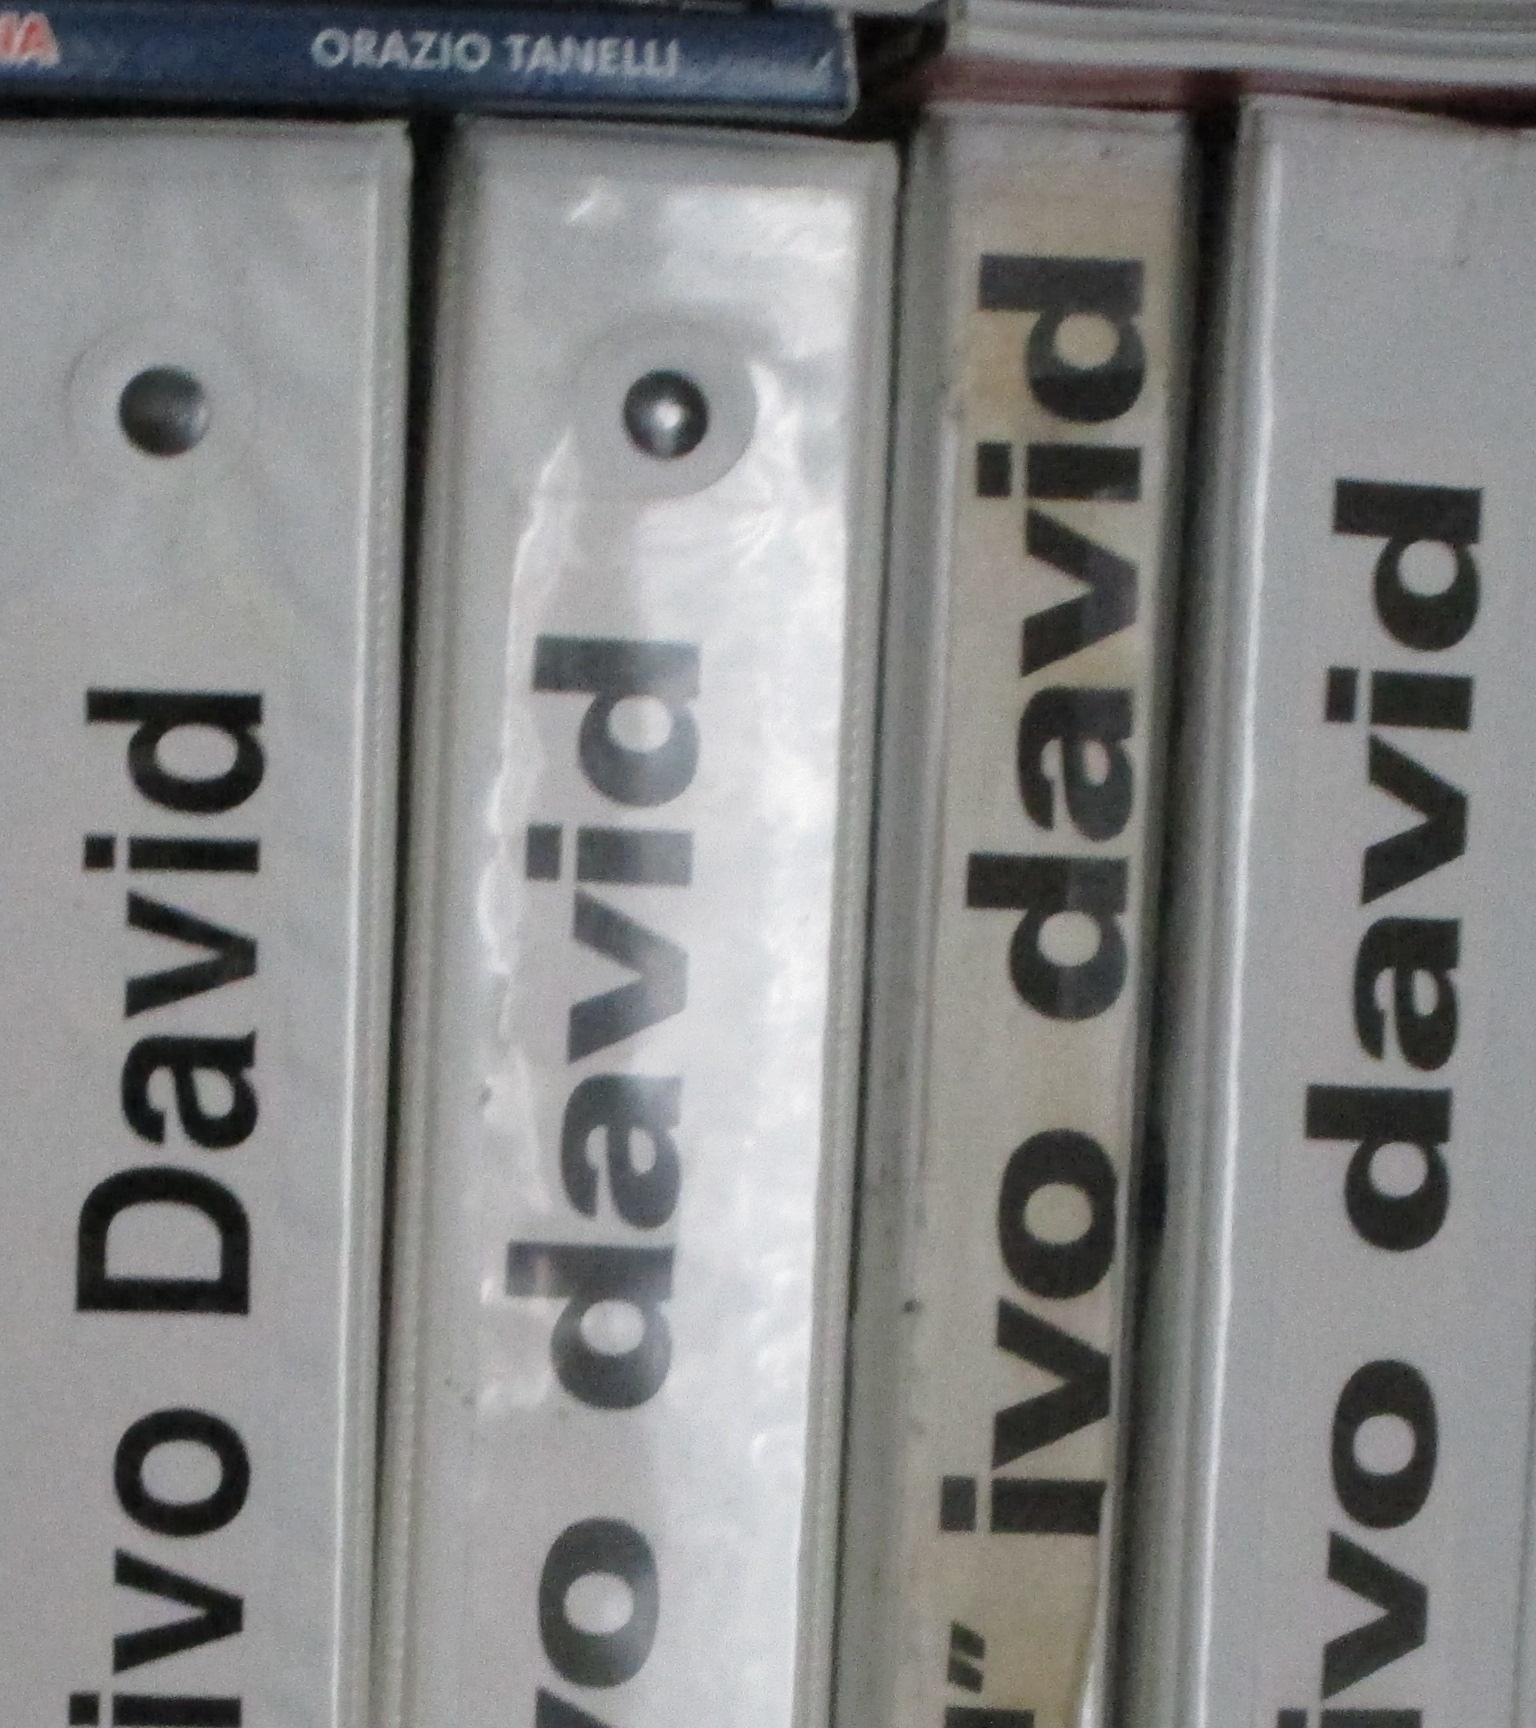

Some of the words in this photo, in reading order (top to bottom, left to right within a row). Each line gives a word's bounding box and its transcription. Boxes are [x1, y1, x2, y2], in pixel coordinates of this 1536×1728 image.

[310, 28, 492, 72] ORAZIO
[504, 34, 682, 78] TANELLI
[965, 254, 1147, 1022] david
[1304, 478, 1483, 1253] david
[75, 688, 266, 1317] David
[505, 634, 689, 1413] david
[939, 1128, 1120, 1539] ivo
